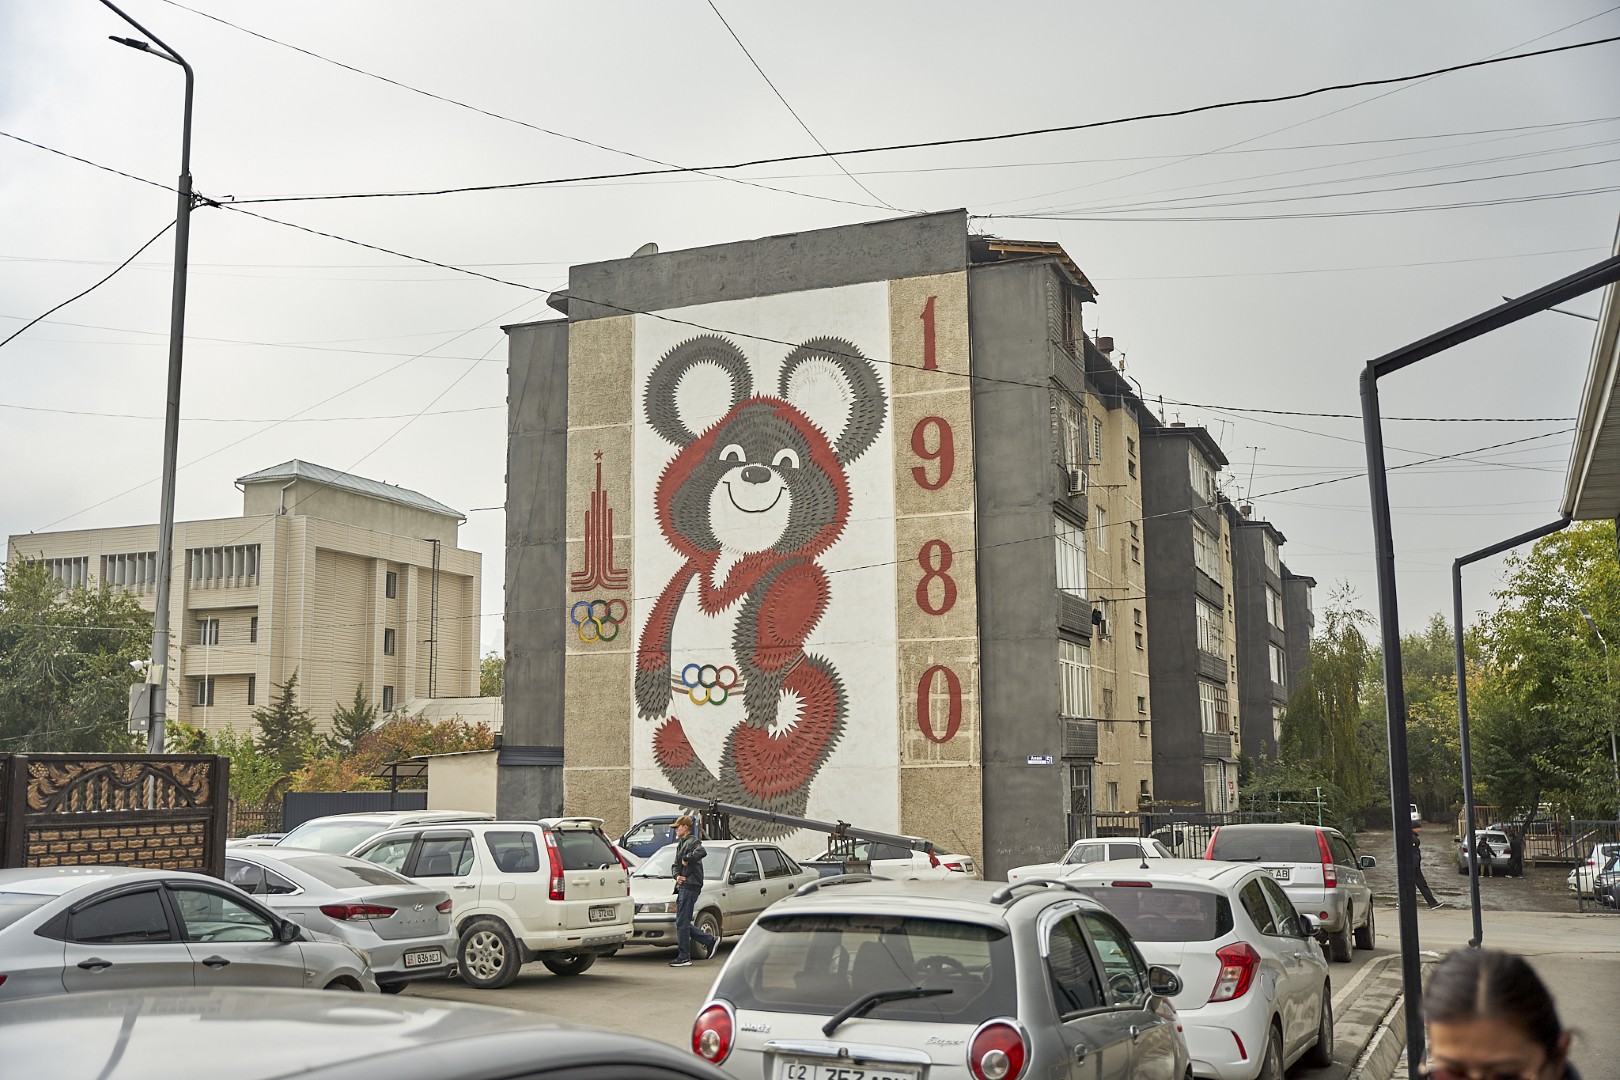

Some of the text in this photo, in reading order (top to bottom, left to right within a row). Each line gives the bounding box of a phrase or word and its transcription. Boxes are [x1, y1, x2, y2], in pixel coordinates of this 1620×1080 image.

[910, 295, 963, 744] 1980
[1046, 756, 1053, 764] 51
[1276, 870, 1288, 878] AB
[417, 953, 429, 963] 836
[741, 1022, 771, 1034] Matiz
[925, 1036, 965, 1047] Super
